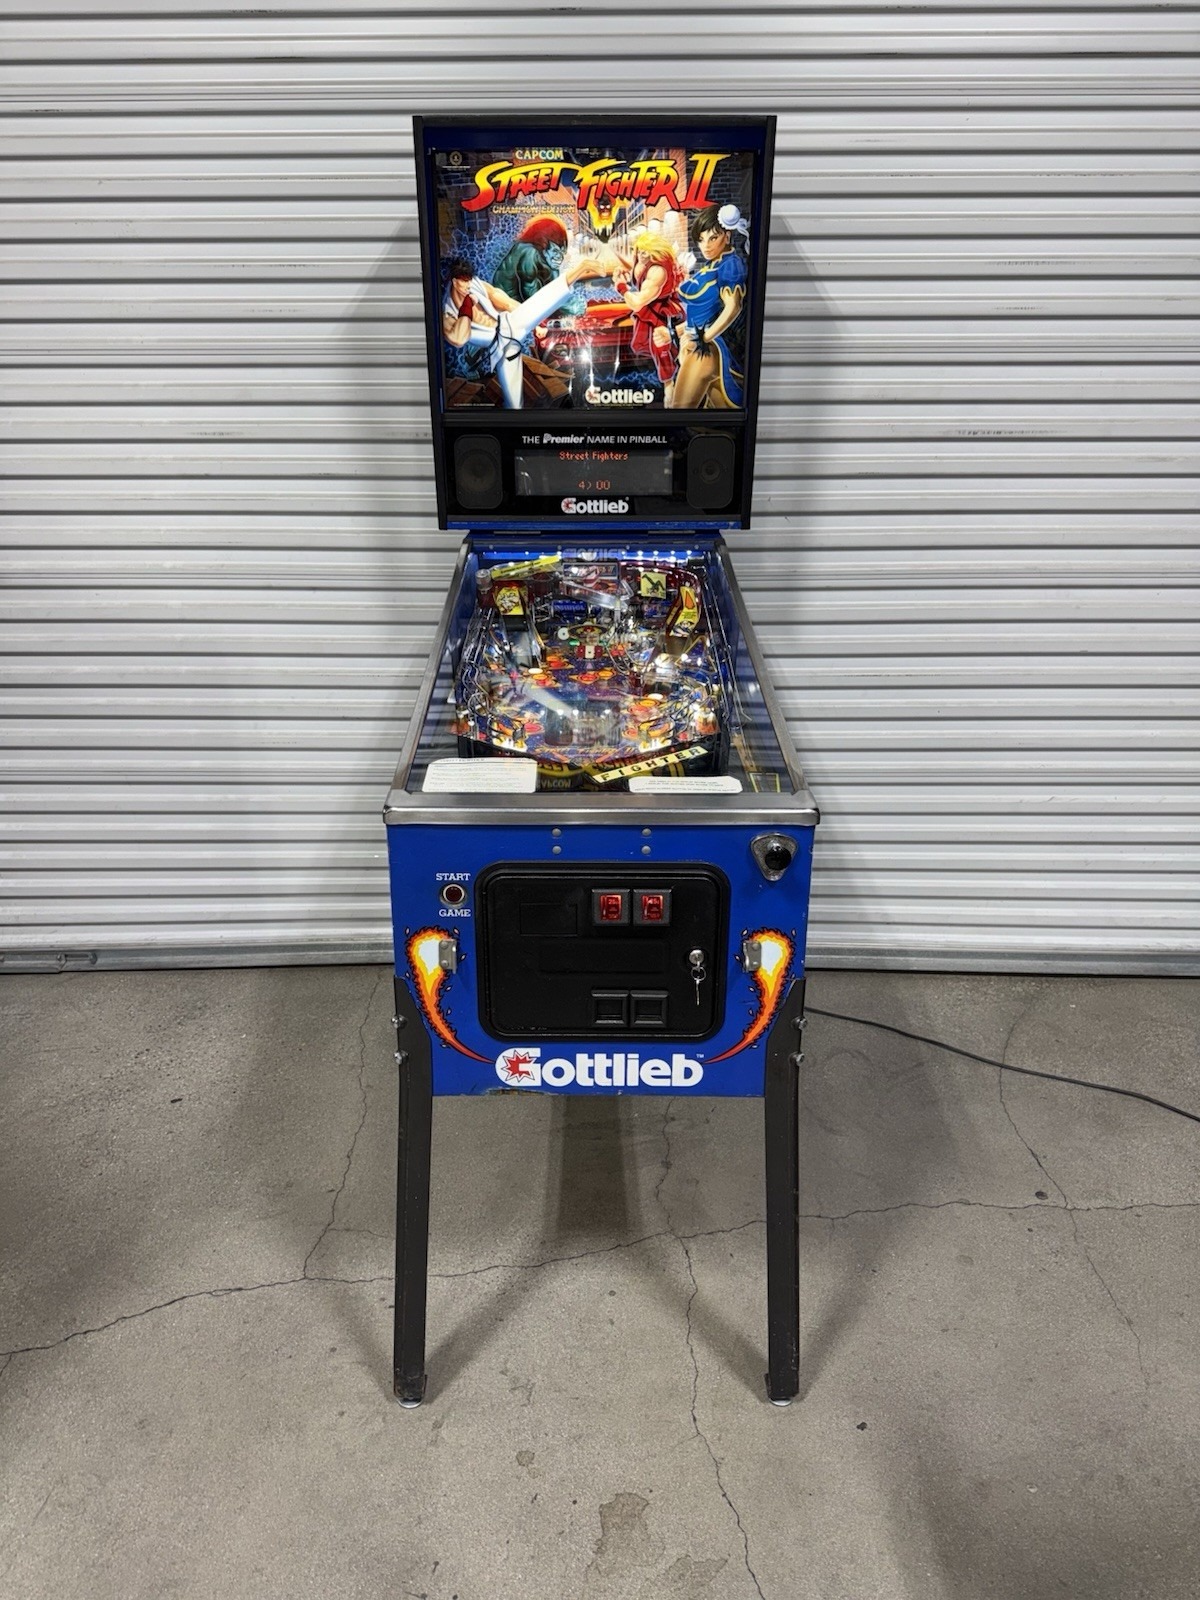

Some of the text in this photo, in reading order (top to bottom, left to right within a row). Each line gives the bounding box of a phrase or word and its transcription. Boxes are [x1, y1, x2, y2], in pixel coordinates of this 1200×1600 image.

[515, 150, 564, 160] CAPCOM
[461, 153, 732, 212] STREET FIGHTER II
[492, 204, 575, 214] CHAMPION EDITION
[585, 386, 655, 404] Gottlieb
[522, 433, 668, 444] THE Premier NAME IN PINBALL
[559, 451, 629, 462] Street Fighters
[560, 497, 629, 514] Gottlieb
[599, 748, 703, 780] FIGHTER
[435, 872, 471, 881] START
[438, 908, 472, 917] GAME
[495, 1047, 704, 1087] Gottlieb
